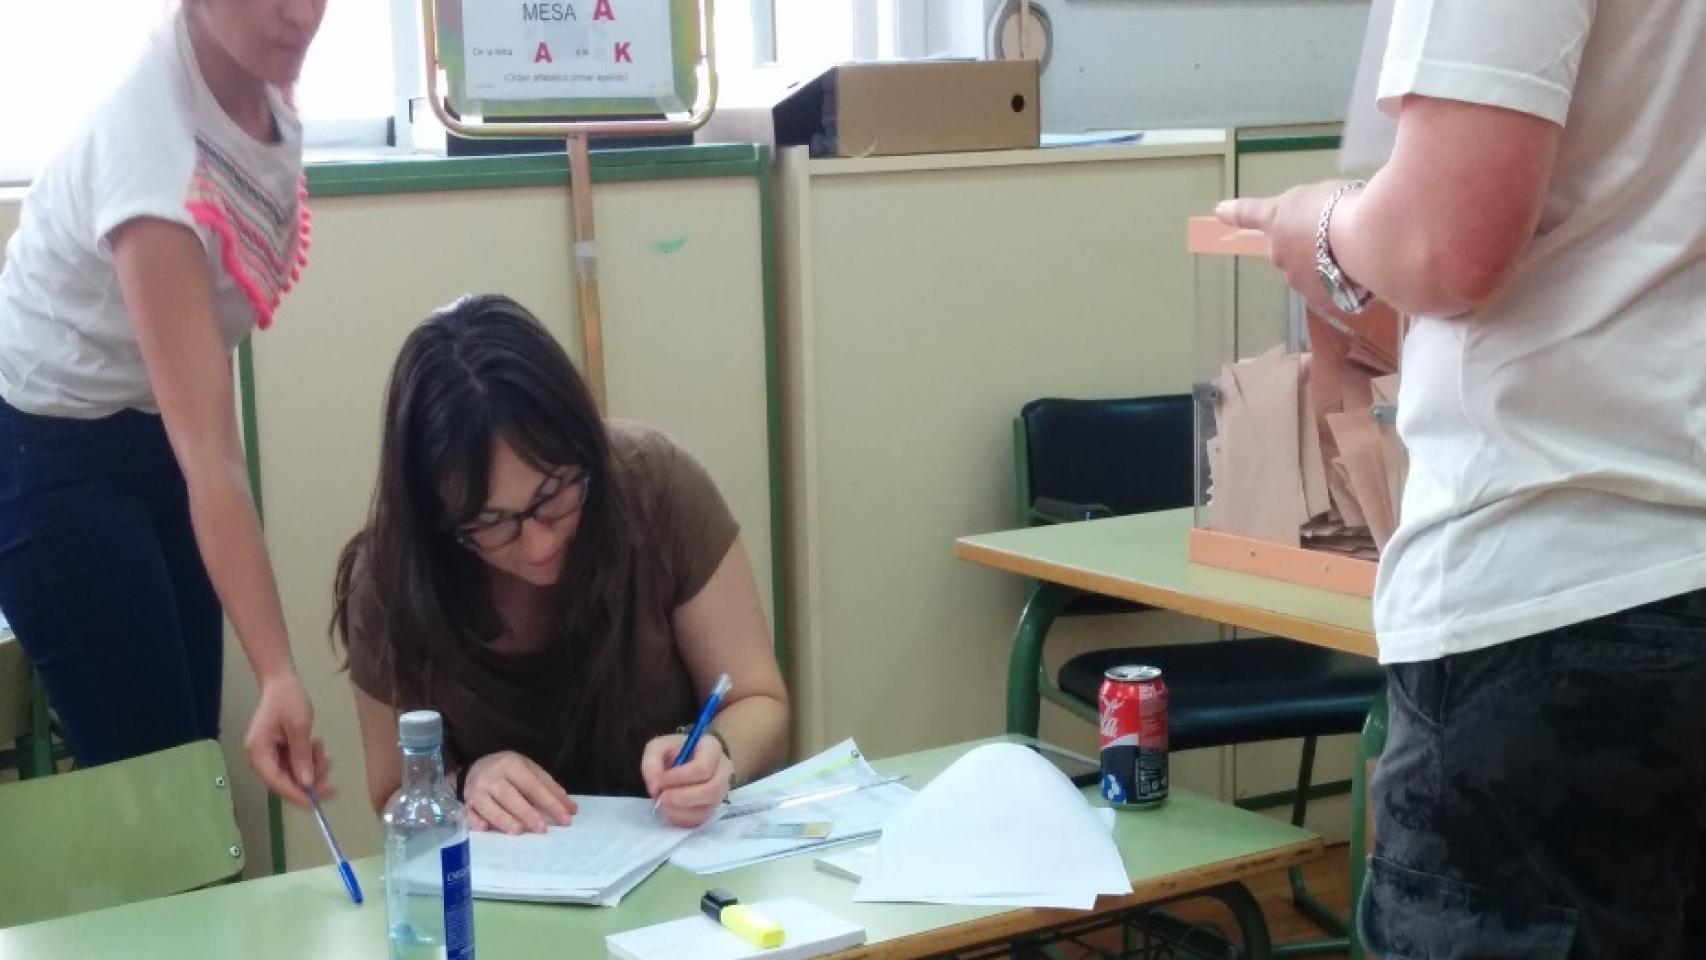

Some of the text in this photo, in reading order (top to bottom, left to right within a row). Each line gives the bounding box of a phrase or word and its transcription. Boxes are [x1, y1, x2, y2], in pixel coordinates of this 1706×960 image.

[522, 0, 616, 21] MESA A
[472, 47, 484, 56] De
[534, 41, 553, 63] A
[614, 41, 633, 64] K
